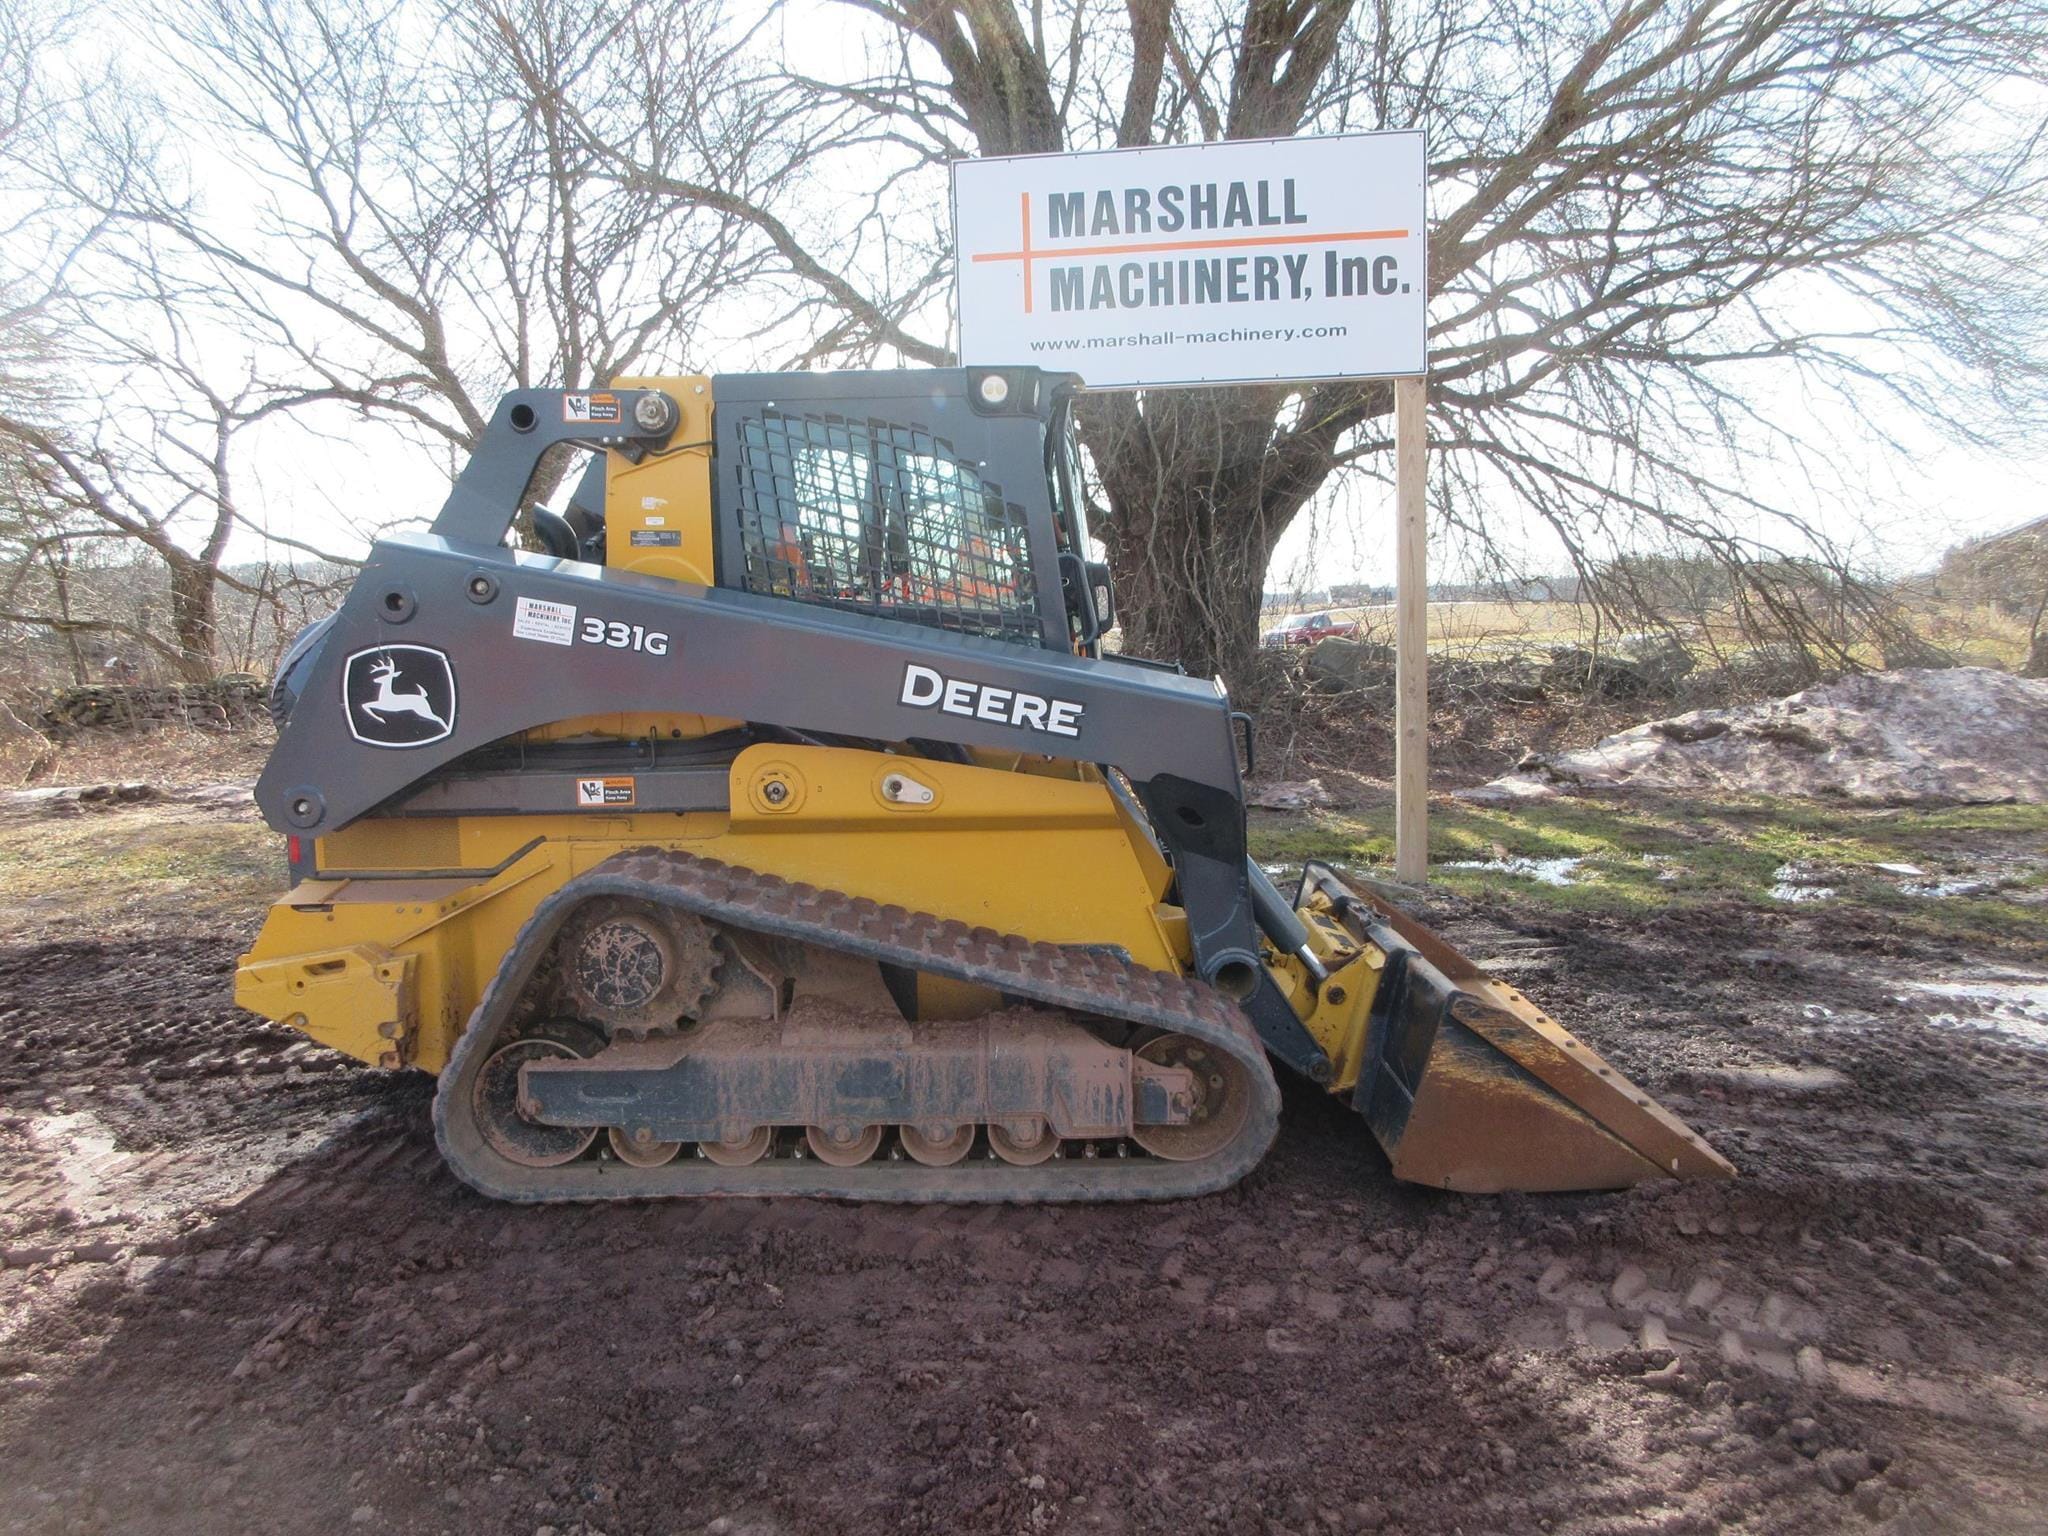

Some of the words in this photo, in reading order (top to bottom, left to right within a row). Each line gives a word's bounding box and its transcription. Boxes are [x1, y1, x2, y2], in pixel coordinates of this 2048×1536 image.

[1048, 178, 1308, 238] MARSHALL
[1050, 253, 1312, 312] MACHINERY,
[1325, 250, 1411, 298] Inc.
[1029, 324, 1348, 352] www.marshall-machinery.com
[581, 617, 668, 655] 331G
[901, 664, 1083, 736] DEERE
